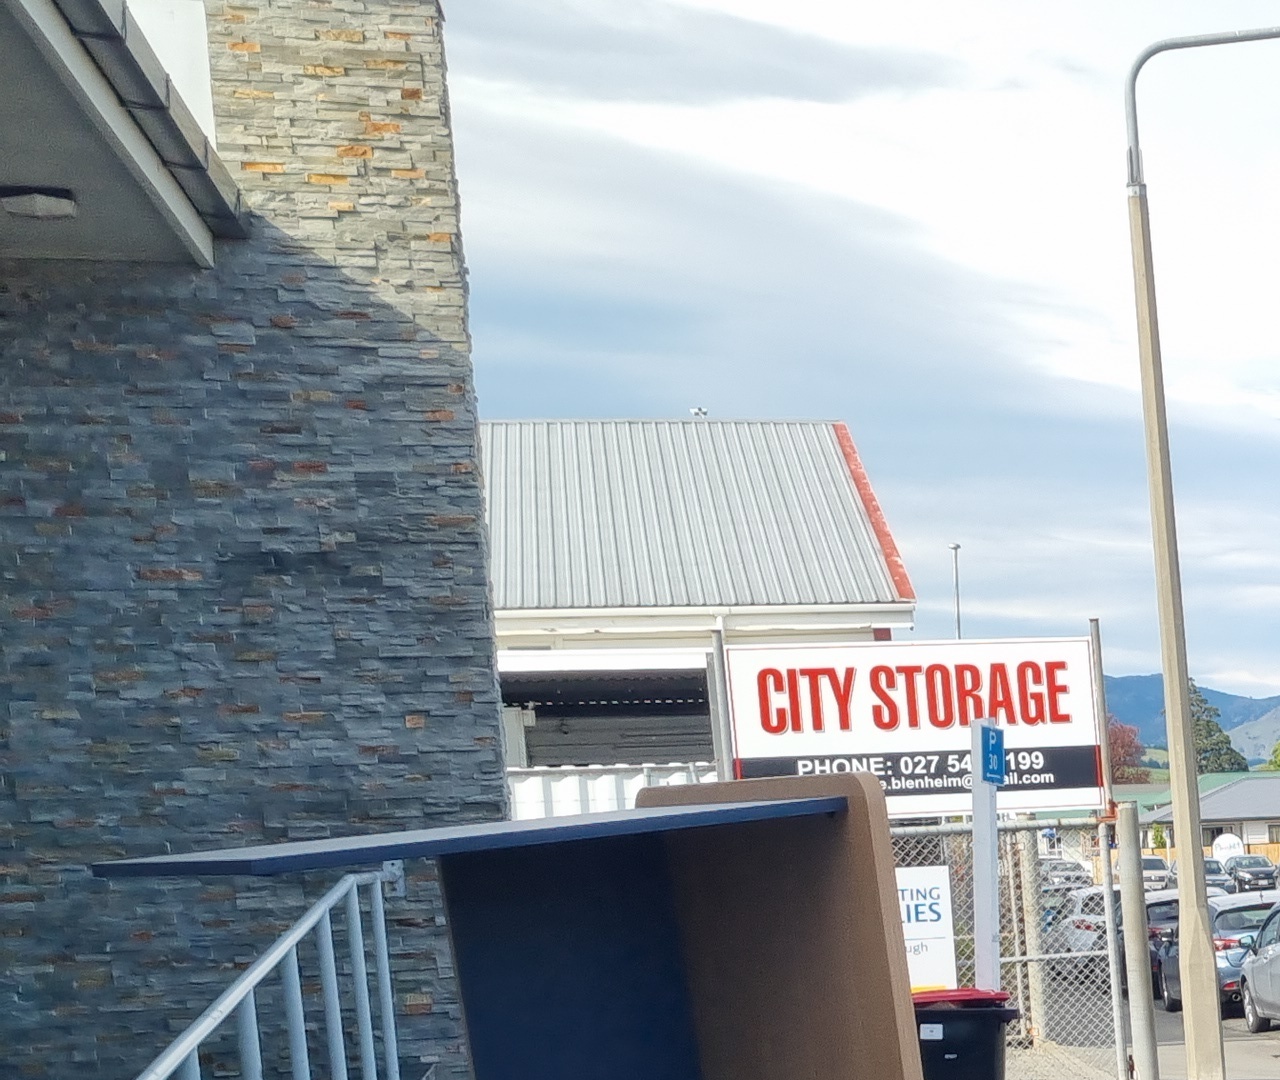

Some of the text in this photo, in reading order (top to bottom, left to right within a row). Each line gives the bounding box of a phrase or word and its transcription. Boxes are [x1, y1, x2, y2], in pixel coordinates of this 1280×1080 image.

[756, 661, 1072, 735] CITY STORAGE
[989, 730, 997, 751] P
[797, 750, 1044, 776] PHONE: 027 54 199
[901, 902, 942, 923] IES
